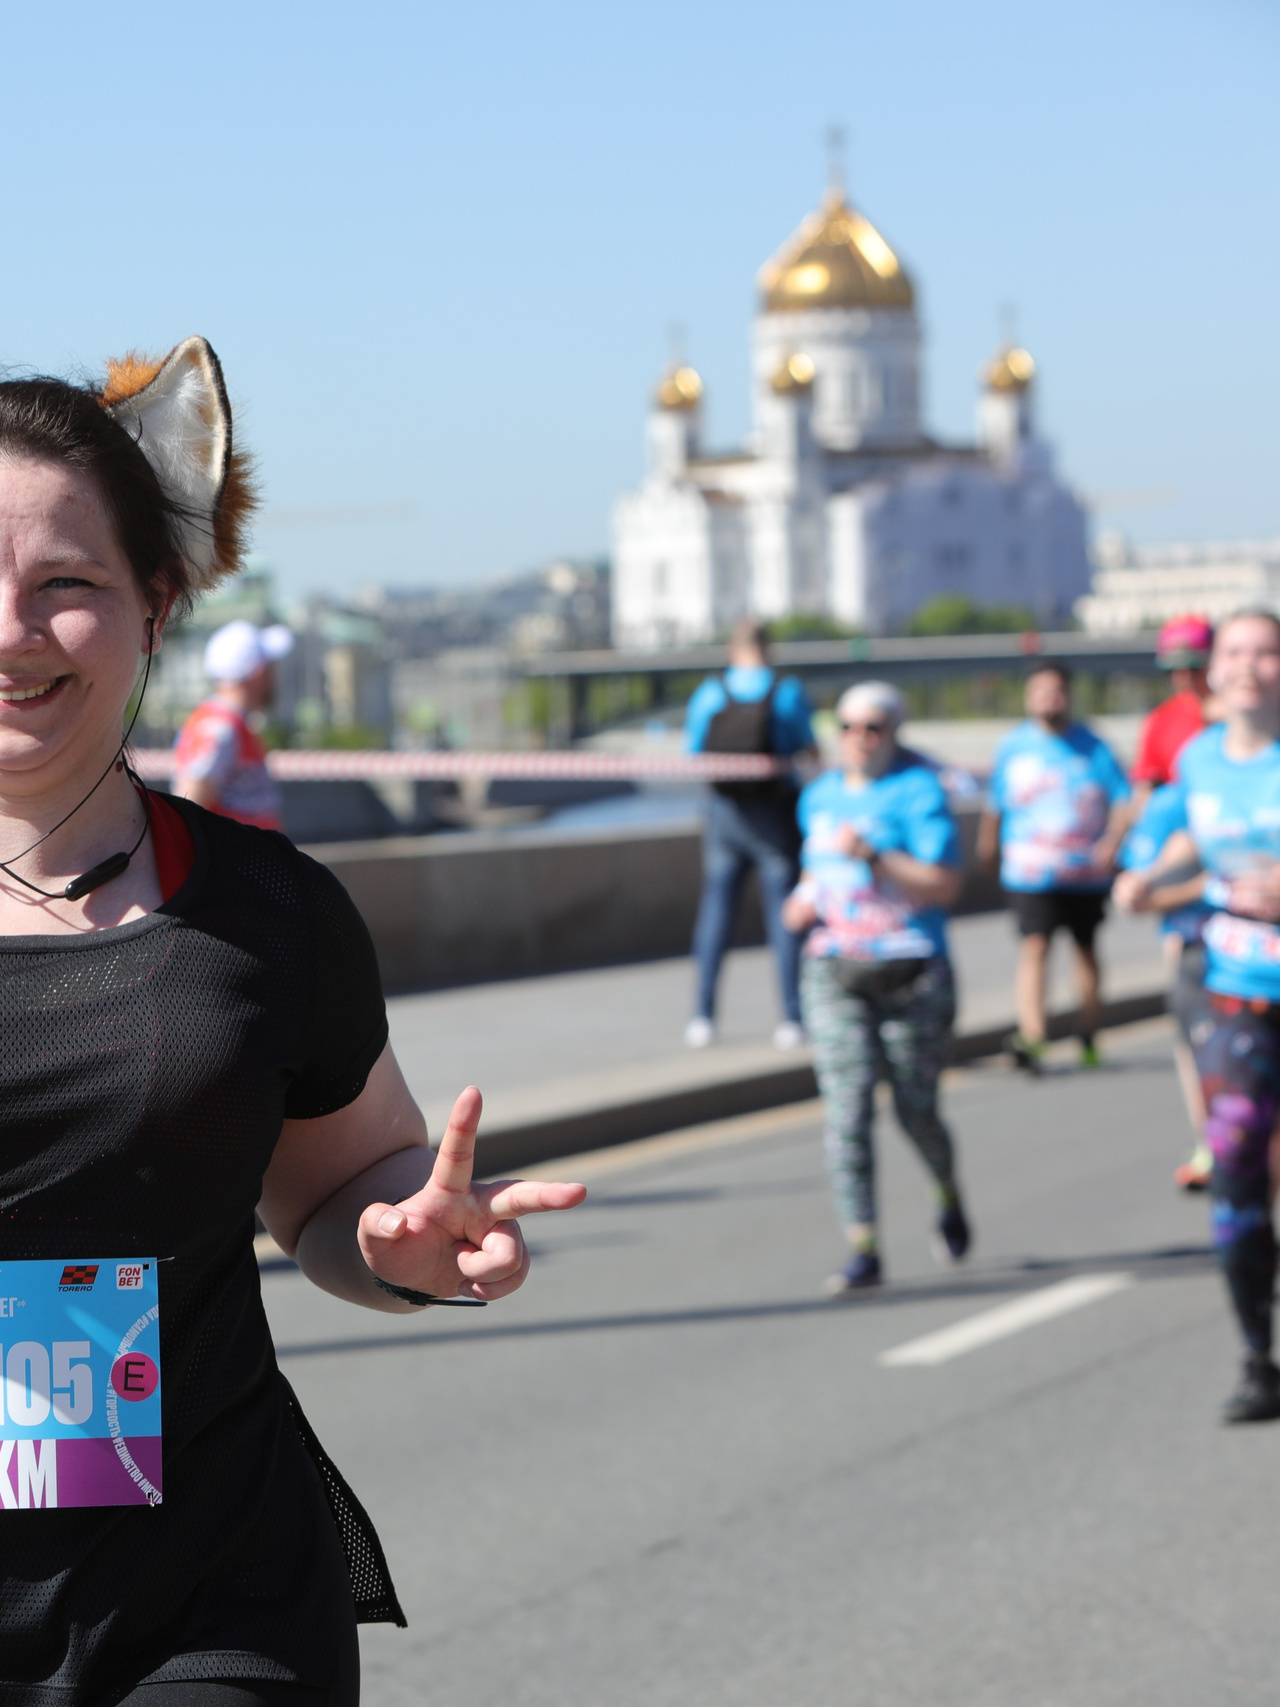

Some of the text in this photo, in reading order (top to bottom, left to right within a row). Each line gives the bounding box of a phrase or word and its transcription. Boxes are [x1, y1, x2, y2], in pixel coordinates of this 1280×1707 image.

[118, 1267, 141, 1276] FON
[57, 1285, 93, 1293] TORERO
[118, 1277, 141, 1287] BET
[124, 1361, 146, 1392] E
[106, 1388, 122, 1438] #ГОРДОСТЬ
[113, 1437, 144, 1483] #ЕДИНСТВО
